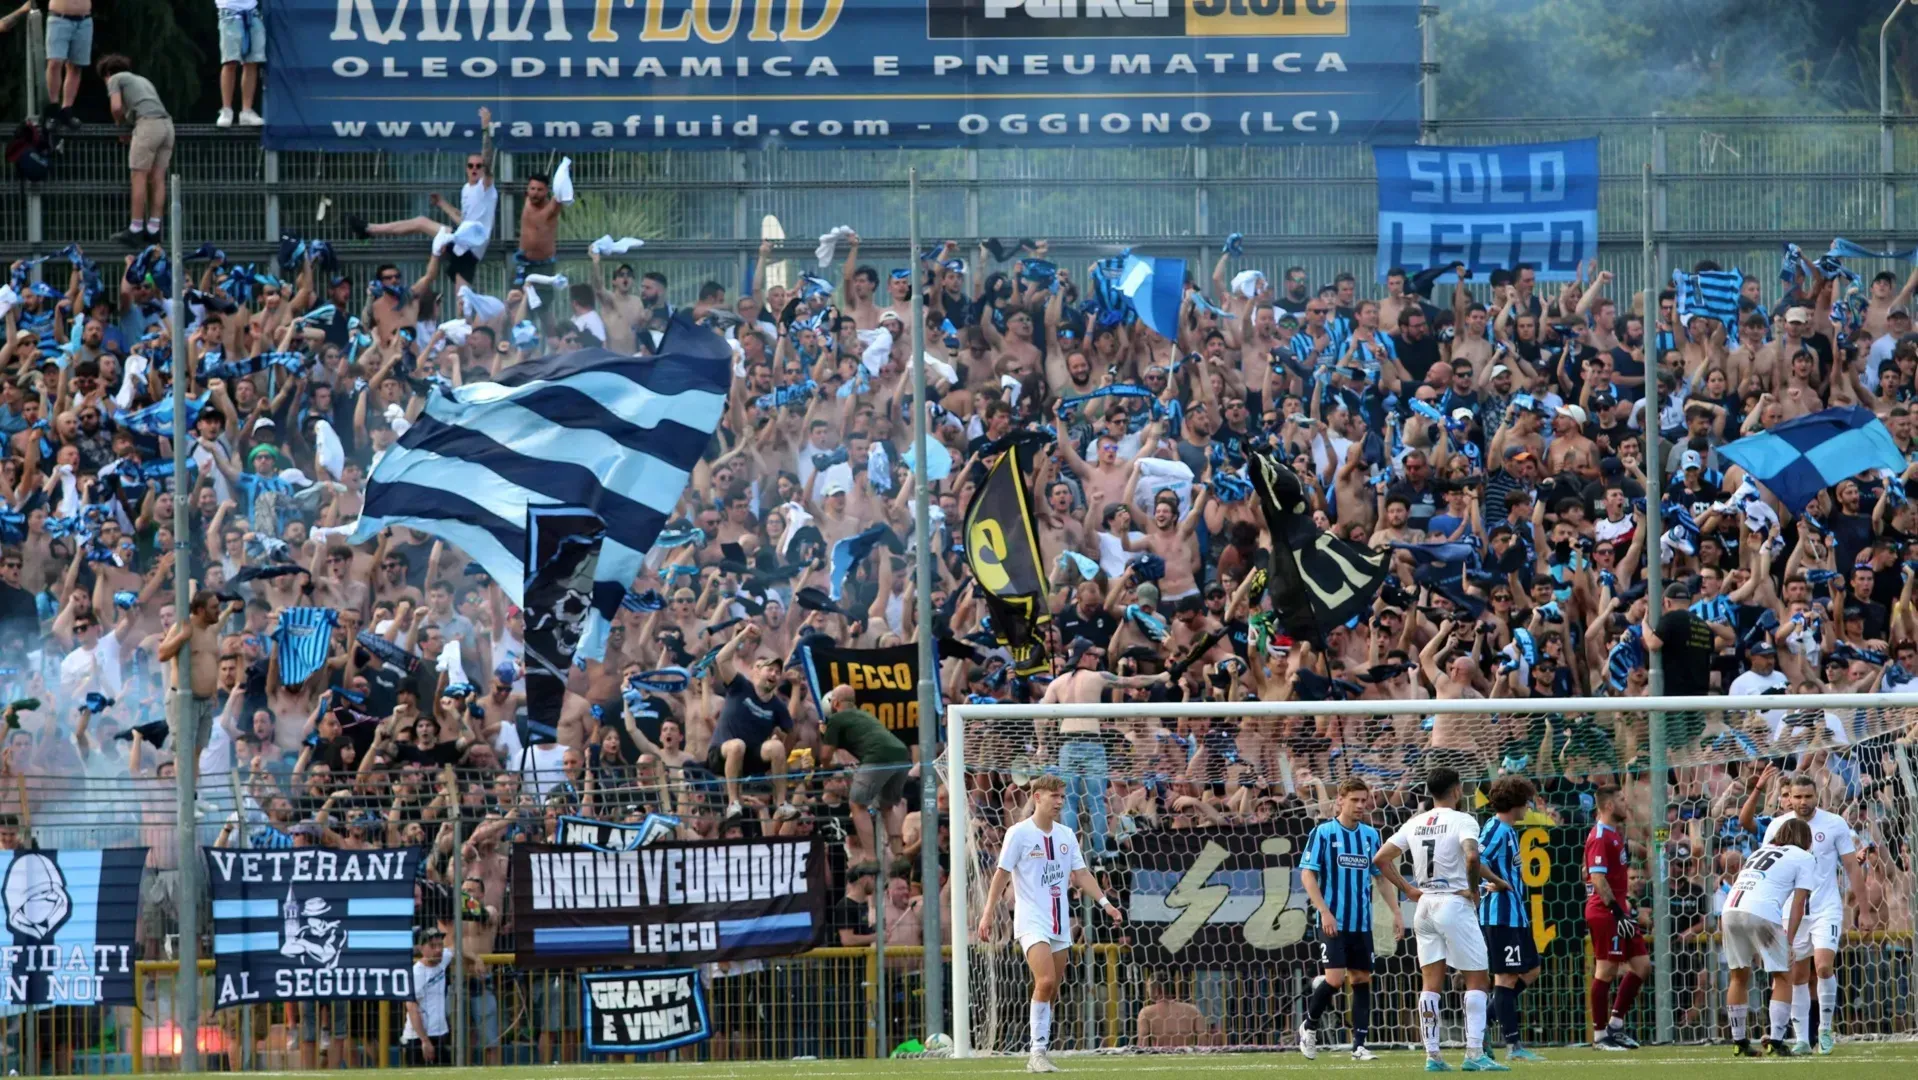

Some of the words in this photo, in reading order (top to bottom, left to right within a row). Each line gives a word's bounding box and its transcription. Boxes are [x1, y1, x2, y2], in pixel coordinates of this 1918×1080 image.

[332, 56, 839, 78] OLEODINAMICA
[873, 55, 900, 76] E
[933, 52, 1348, 76] PNEUMATICA
[332, 114, 889, 137] www.ramafluid.com
[958, 112, 1212, 135] OGGIONO
[1240, 110, 1340, 134] (LC)
[1407, 150, 1565, 204] SOLO
[1391, 220, 1584, 273] LECCO
[211, 850, 408, 882] VETERANI
[1422, 839, 1436, 878] 7
[633, 920, 717, 953] LECCO
[1320, 943, 1327, 960] 2
[1611, 935, 1618, 951] 1
[0, 944, 130, 973] FIDATI
[1504, 945, 1521, 962] 21
[46, 975, 104, 1001] NOI
[218, 971, 260, 1004] AL
[276, 967, 410, 997] SEGUITO
[590, 976, 691, 1010] GRAPPA
[602, 1013, 618, 1041] E
[622, 1003, 691, 1042] VINCI
